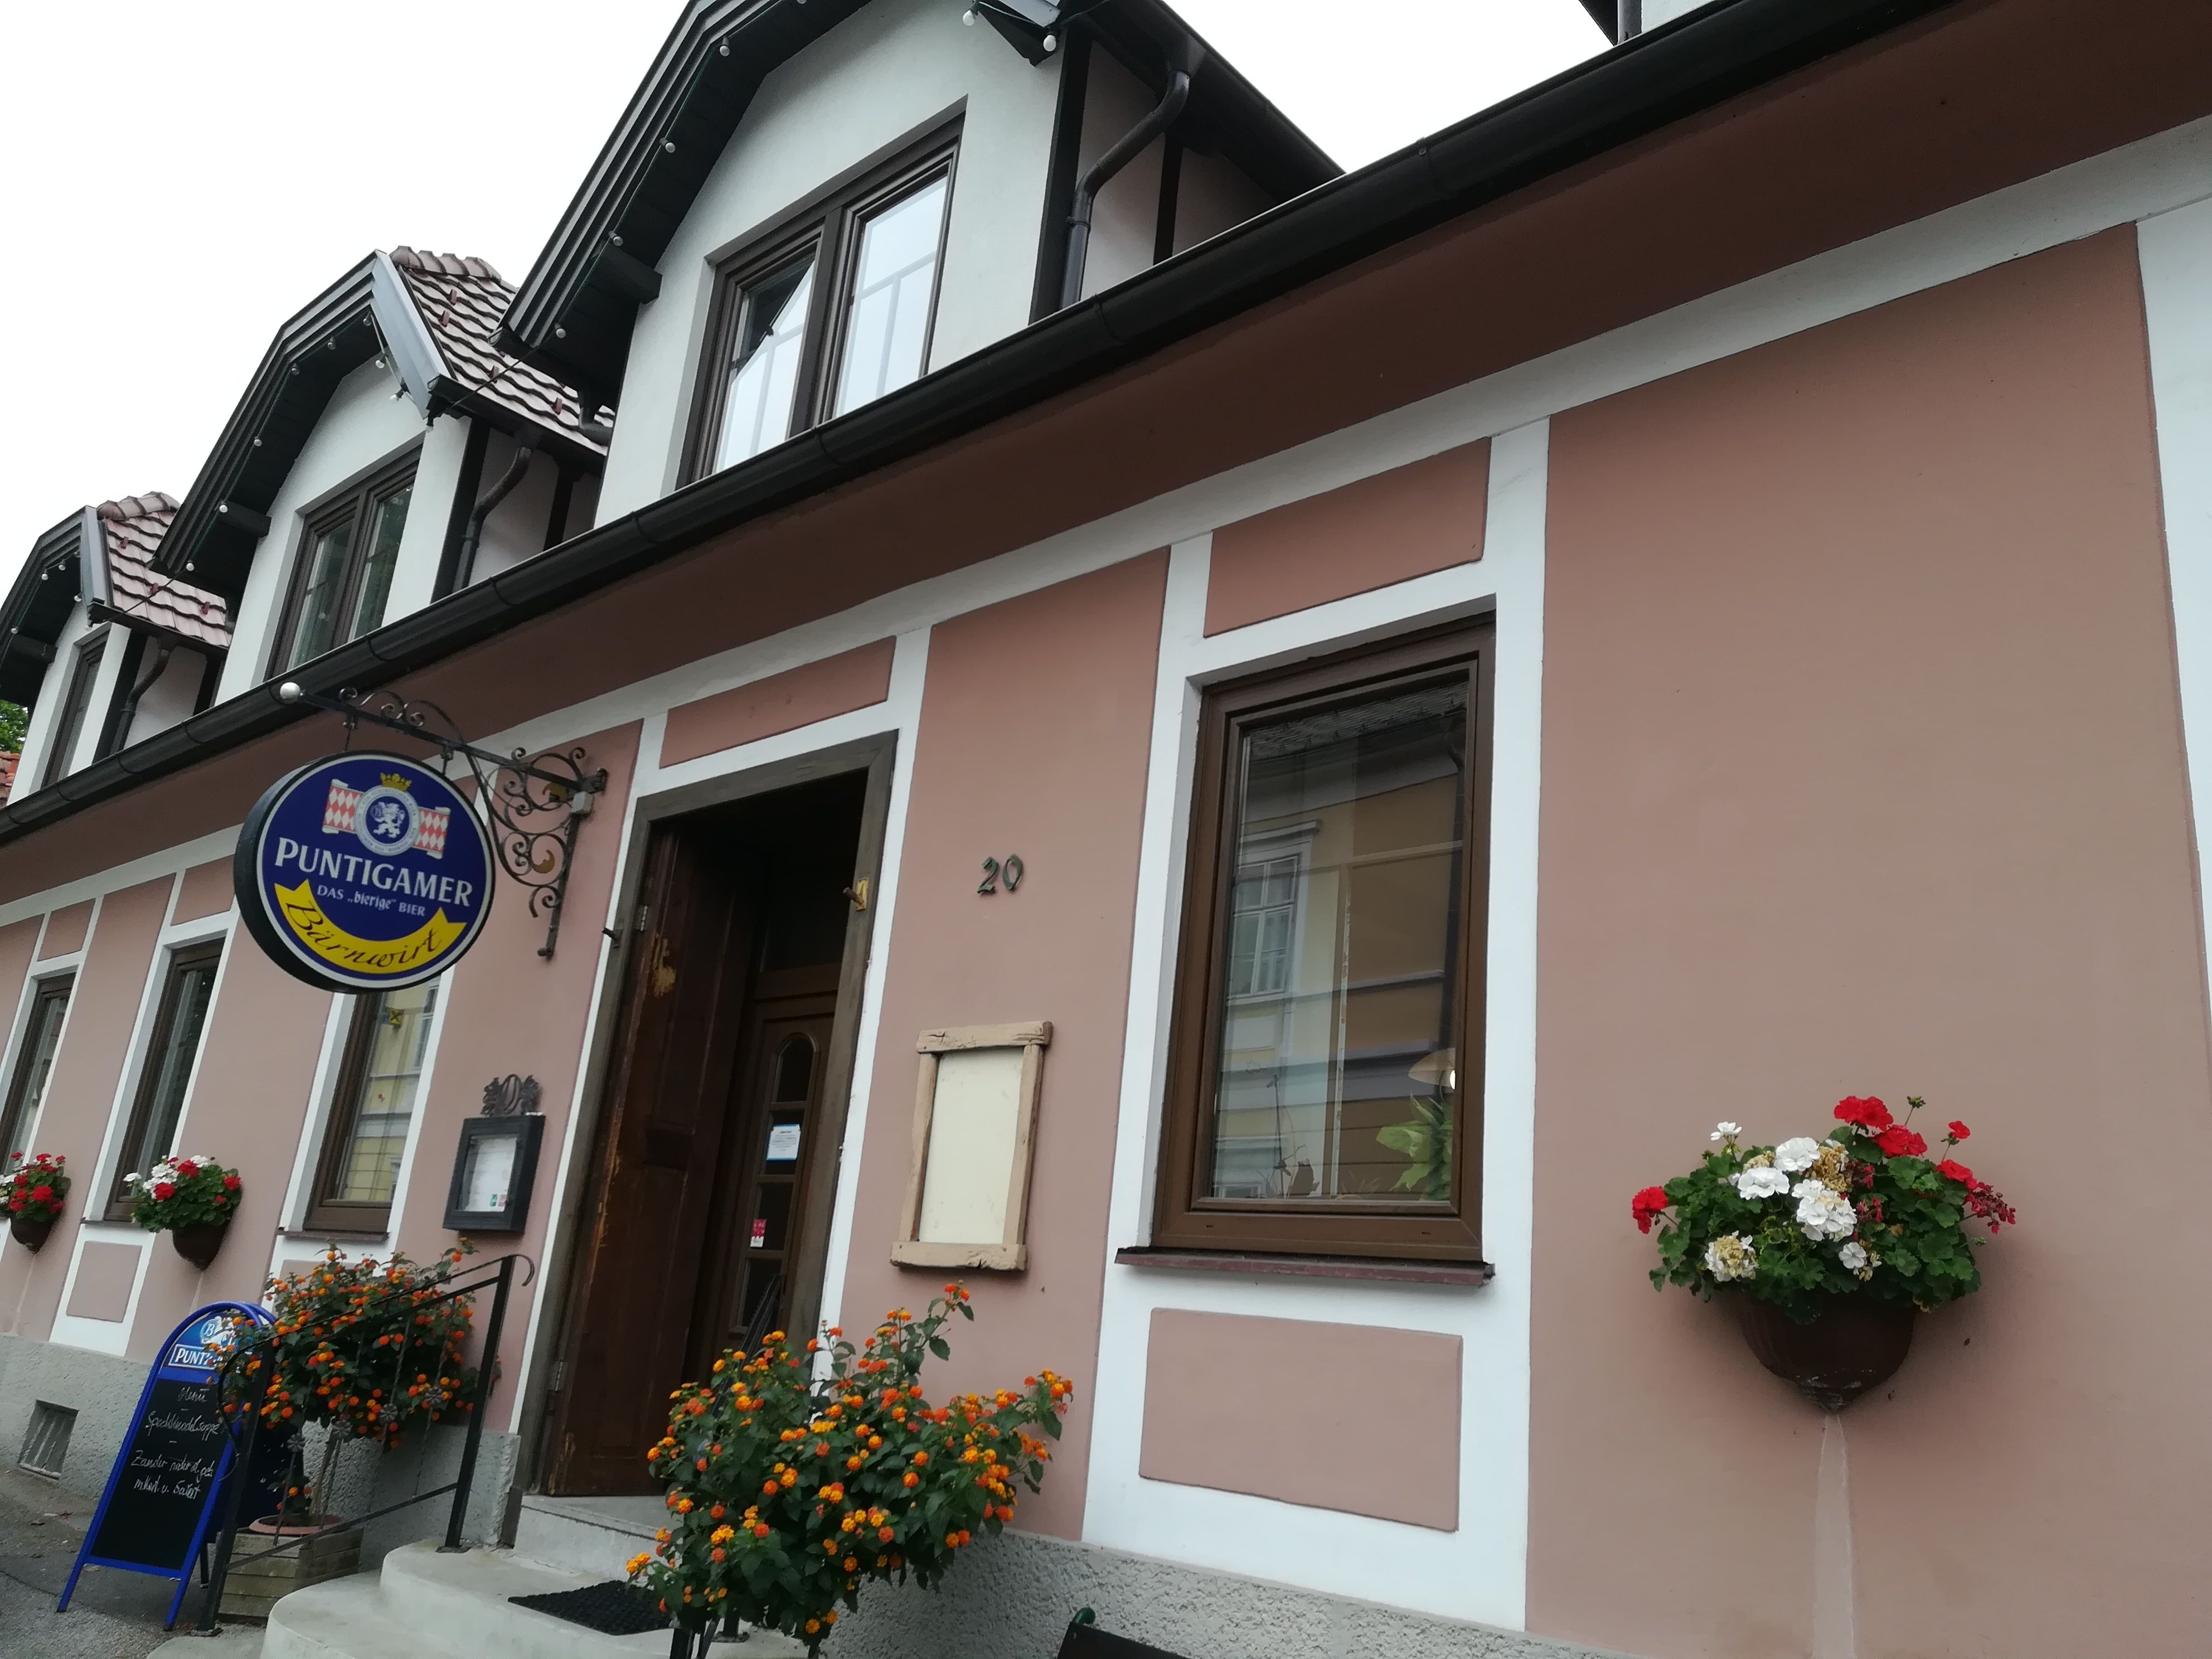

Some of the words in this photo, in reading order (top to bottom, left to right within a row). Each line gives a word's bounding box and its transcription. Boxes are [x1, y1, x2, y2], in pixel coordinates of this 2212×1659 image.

[275, 837, 473, 907] PUNTIGAMER
[977, 853, 1023, 894] 20
[317, 885, 344, 900] DAS
[399, 901, 426, 916] BIER
[286, 900, 442, 967] Bärnwirt
[131, 1450, 168, 1467] Zander
